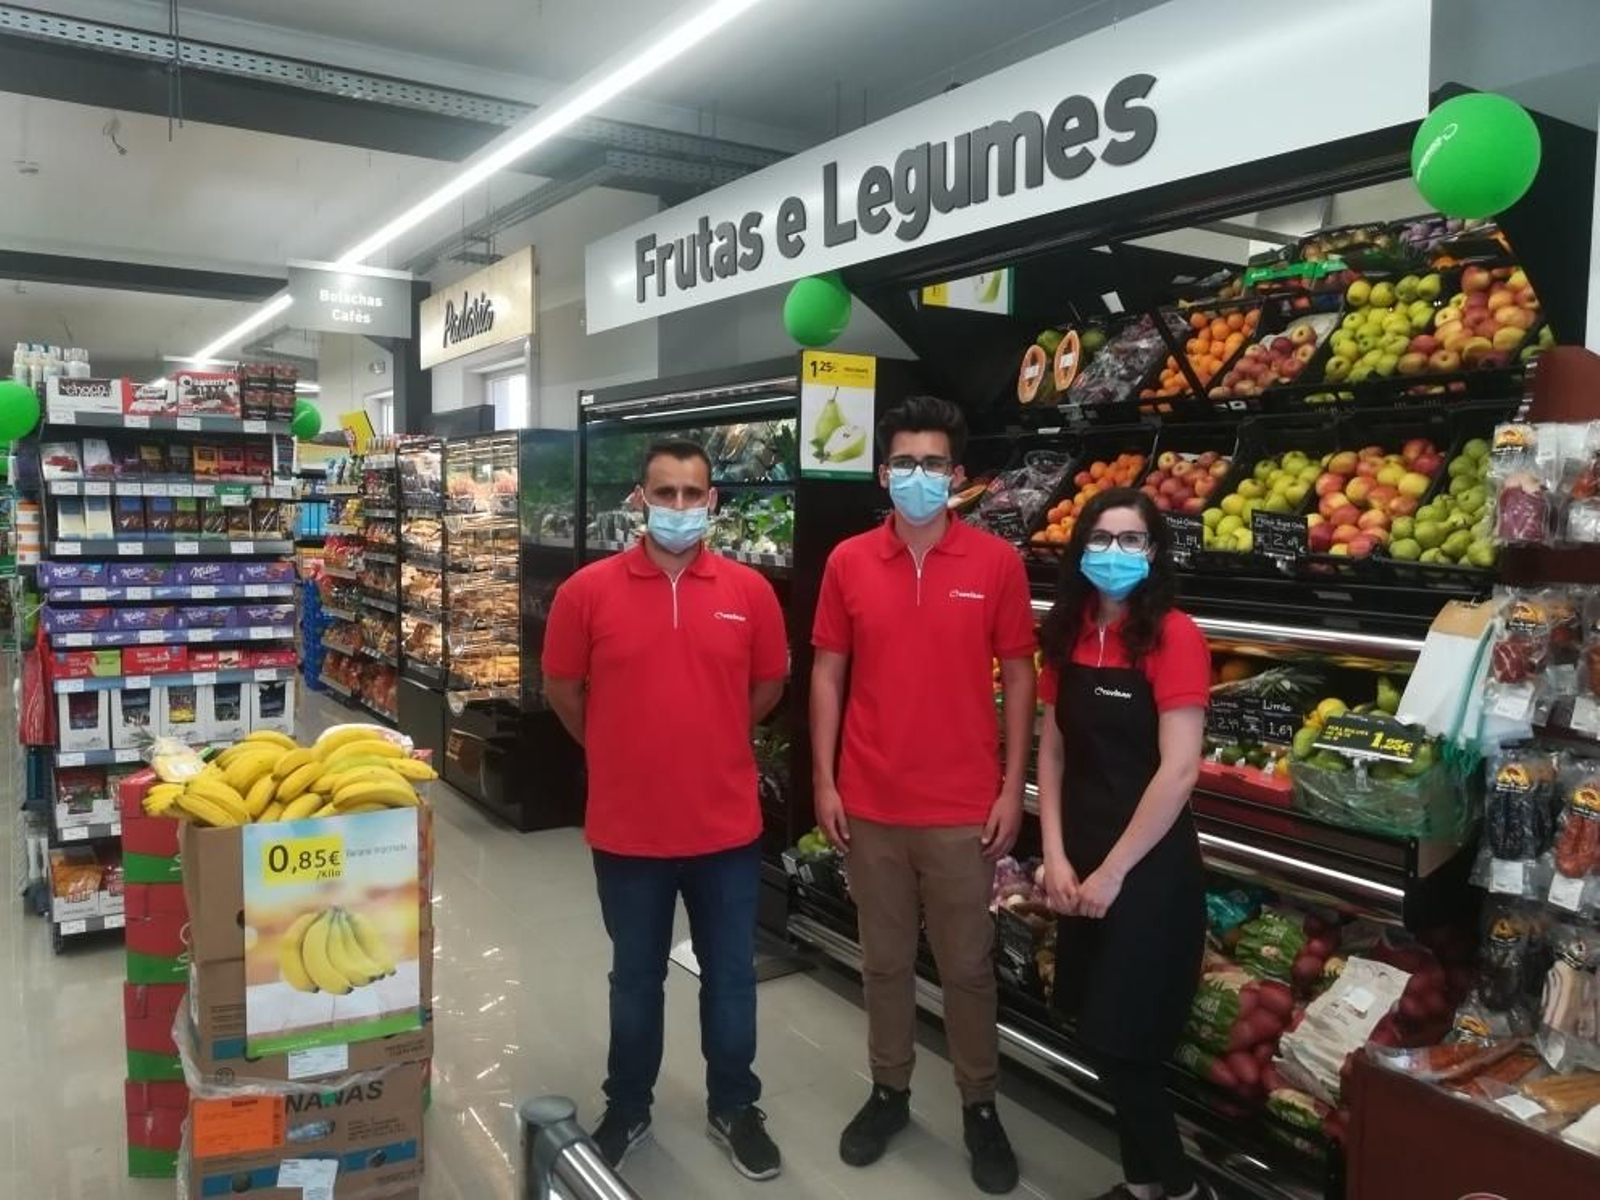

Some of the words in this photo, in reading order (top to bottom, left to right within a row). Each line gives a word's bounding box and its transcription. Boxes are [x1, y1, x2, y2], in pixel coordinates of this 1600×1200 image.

[636, 211, 764, 303] Frutas
[777, 196, 807, 258] e
[823, 73, 1158, 242] Legumes
[319, 288, 383, 307] Bolachas
[268, 845, 341, 874] 0,85€
